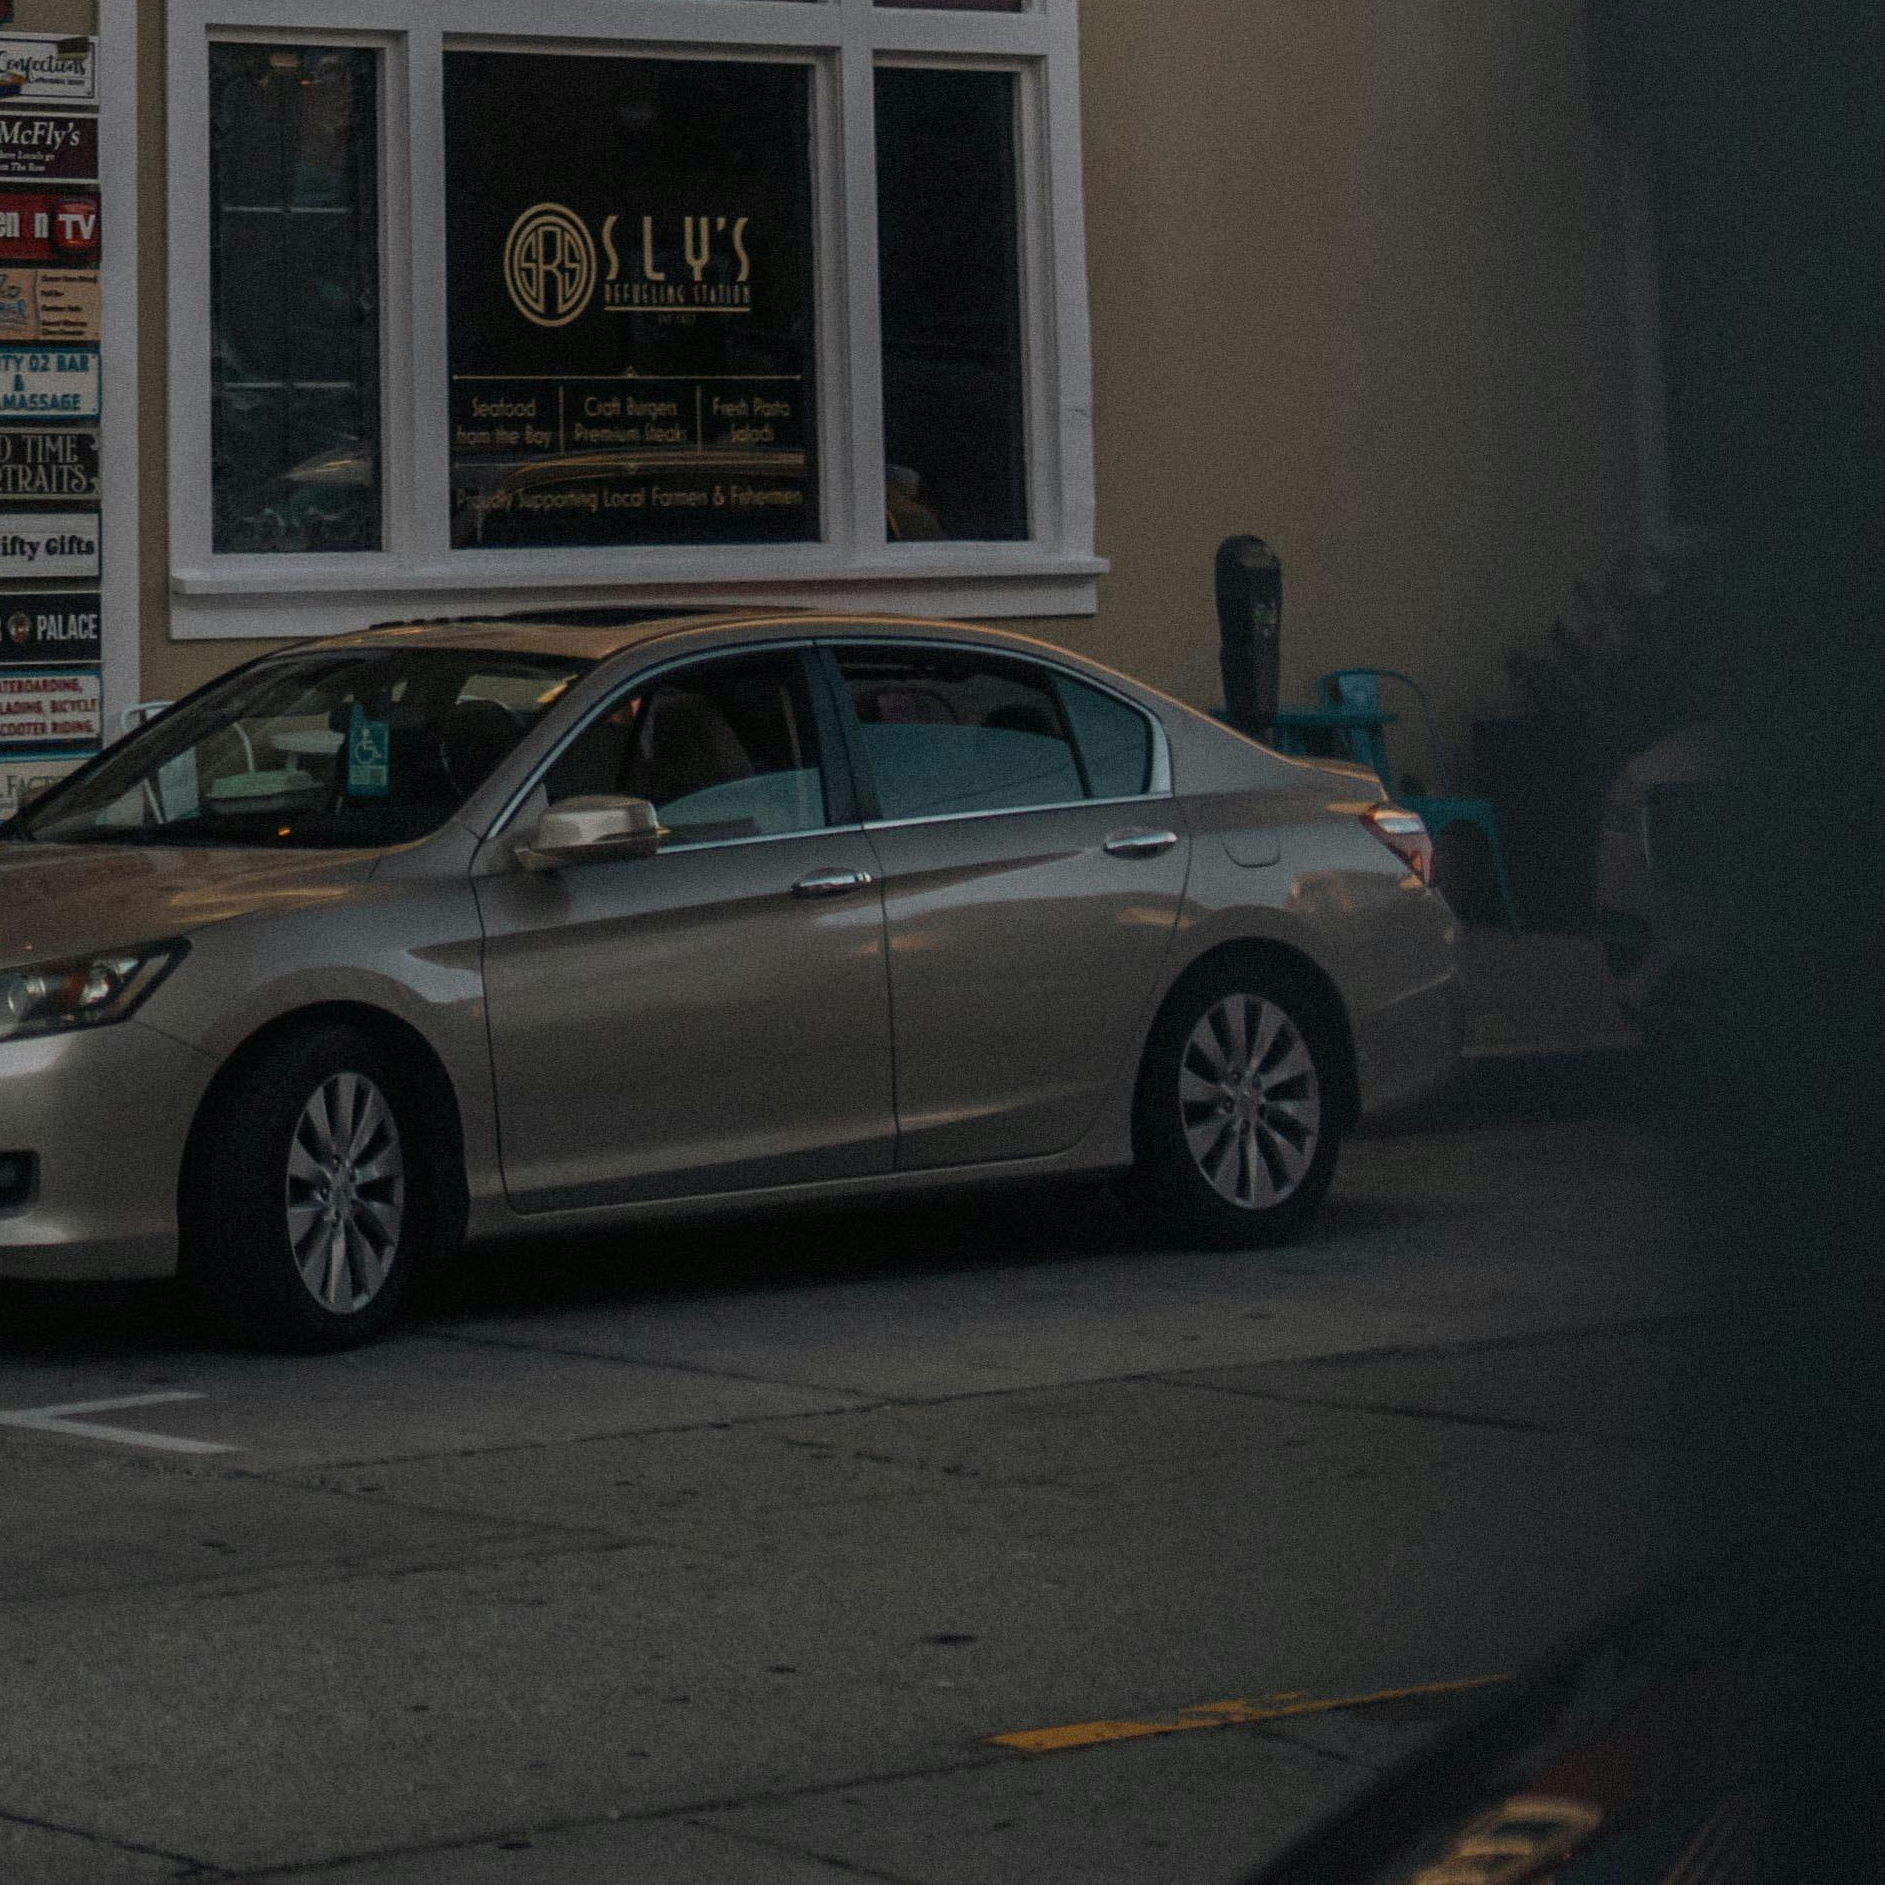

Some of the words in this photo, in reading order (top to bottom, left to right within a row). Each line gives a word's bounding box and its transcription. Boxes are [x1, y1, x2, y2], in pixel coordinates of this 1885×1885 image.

[58, 213, 96, 240] TV
[601, 214, 751, 282] SLY'S
[56, 355, 90, 372] BAR
[472, 396, 537, 418] Seafood
[22, 434, 80, 464] TIME
[602, 487, 646, 508] Local
[45, 535, 96, 556] Gifts
[36, 613, 99, 642] PALACE
[50, 699, 97, 713] BICYCLE
[7, 775, 66, 798] FACT
